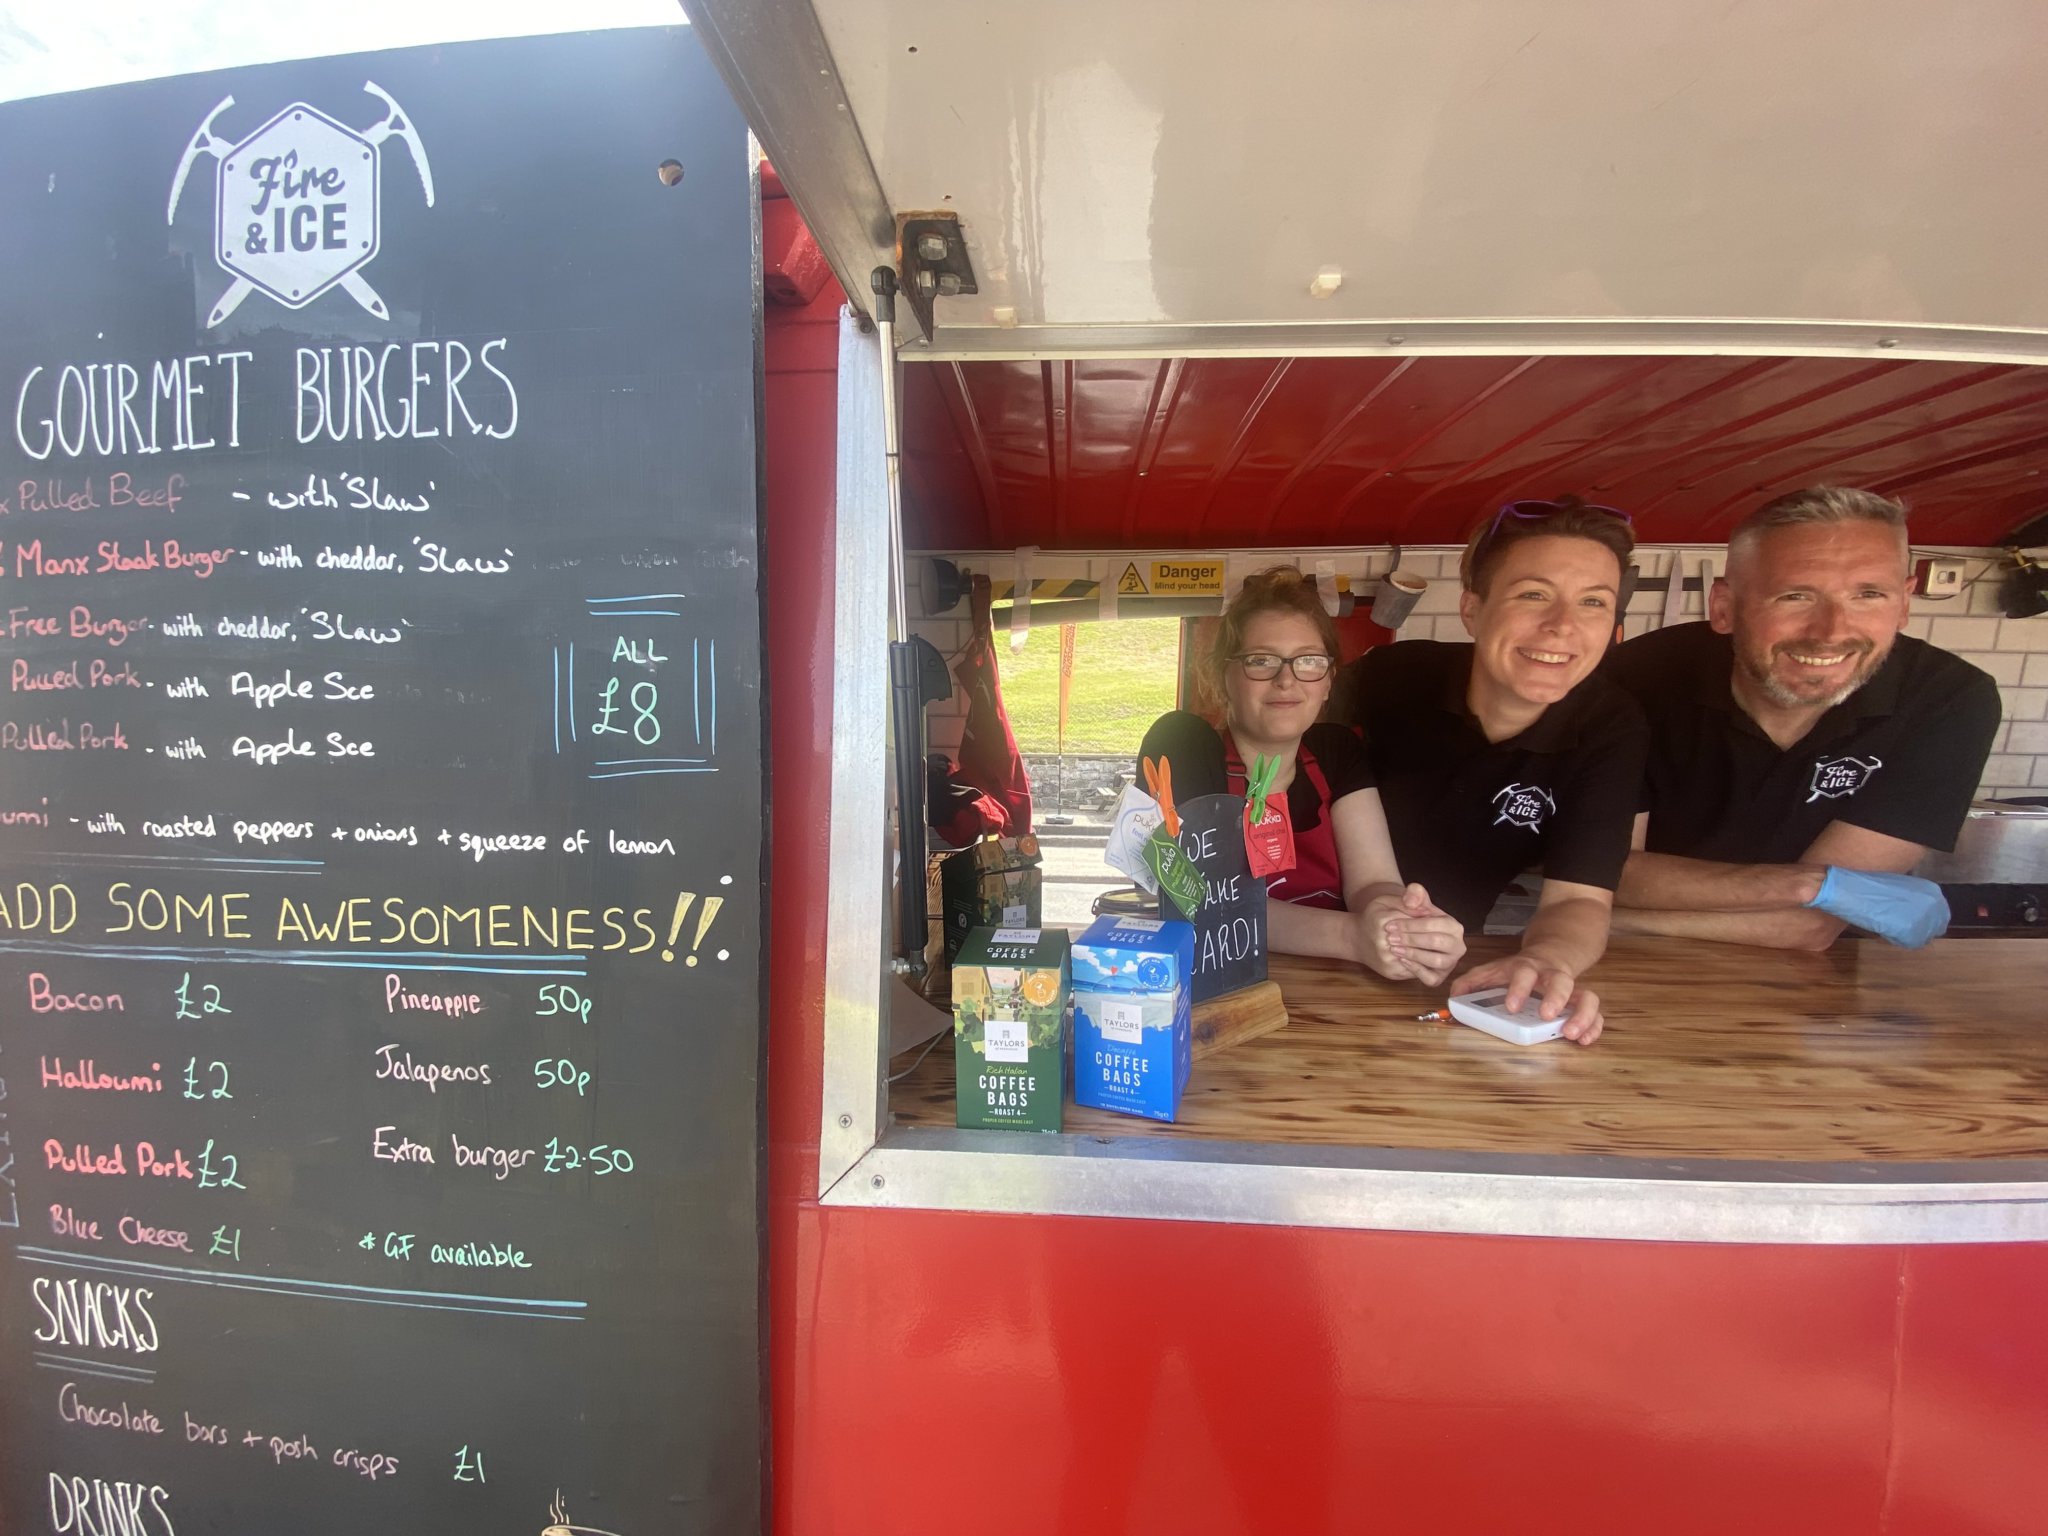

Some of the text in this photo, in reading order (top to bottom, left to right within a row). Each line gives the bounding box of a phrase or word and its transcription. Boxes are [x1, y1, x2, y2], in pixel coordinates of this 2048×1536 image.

[249, 149, 346, 215] Fire
[16, 337, 518, 460] GOURMET BURGERS
[19, 476, 101, 512] Pulled
[110, 472, 187, 513] Beef
[268, 474, 339, 509] with
[16, 539, 90, 578] Manx
[97, 540, 158, 575] Steak
[163, 540, 235, 580] Burger
[257, 544, 304, 570] with
[1159, 564, 1217, 581] Danger
[1154, 582, 1176, 590] Mind
[1177, 583, 1197, 591] your
[9, 606, 62, 639] Free
[70, 606, 148, 646] Burger
[163, 612, 204, 638] with
[612, 635, 669, 664] ALL
[90, 659, 142, 688] Pork
[166, 676, 209, 700] with
[231, 669, 315, 709] Apple
[324, 671, 376, 701] Sce
[591, 676, 662, 745] £8
[80, 722, 129, 751] Pork
[165, 736, 207, 760] with
[232, 728, 316, 766] Apple
[325, 732, 376, 758] Sce
[1513, 794, 1542, 808] Fire
[87, 812, 127, 837] with
[142, 814, 217, 839] roasted
[233, 820, 314, 845] peppers
[354, 822, 418, 847] onions
[459, 831, 547, 862] squeeze
[562, 829, 591, 854] of
[609, 829, 676, 856] lemon
[106, 882, 251, 939] SOME
[28, 972, 232, 1020] Bacon £2
[385, 973, 592, 1024] Pineapple 50p
[988, 1040, 1025, 1048] TAYLORS
[1104, 1018, 1140, 1030] TAYLORS
[41, 1055, 233, 1100] Halloumi £2
[375, 1044, 591, 1096] Jalapenos 50p
[979, 1075, 1036, 1091] COFFEE
[986, 1065, 1028, 1075] Rich Italian
[1095, 1051, 1149, 1073] COFFEE
[1103, 1068, 1141, 1087] BAGS
[987, 1091, 1028, 1107] BAGS
[44, 1138, 247, 1189] Pulled Pork £2
[373, 1125, 435, 1164] Extra
[452, 1133, 536, 1180] burger
[50, 1203, 241, 1261] Blue Cheese £1
[384, 1231, 533, 1268] GF available
[33, 1277, 159, 1353] SNACKS
[58, 1382, 165, 1434] Chocolate
[185, 1411, 228, 1445] bars
[270, 1434, 318, 1465] posh
[333, 1448, 399, 1481] crisps
[454, 1444, 486, 1483] £1
[49, 1471, 175, 1536] DRINKS
